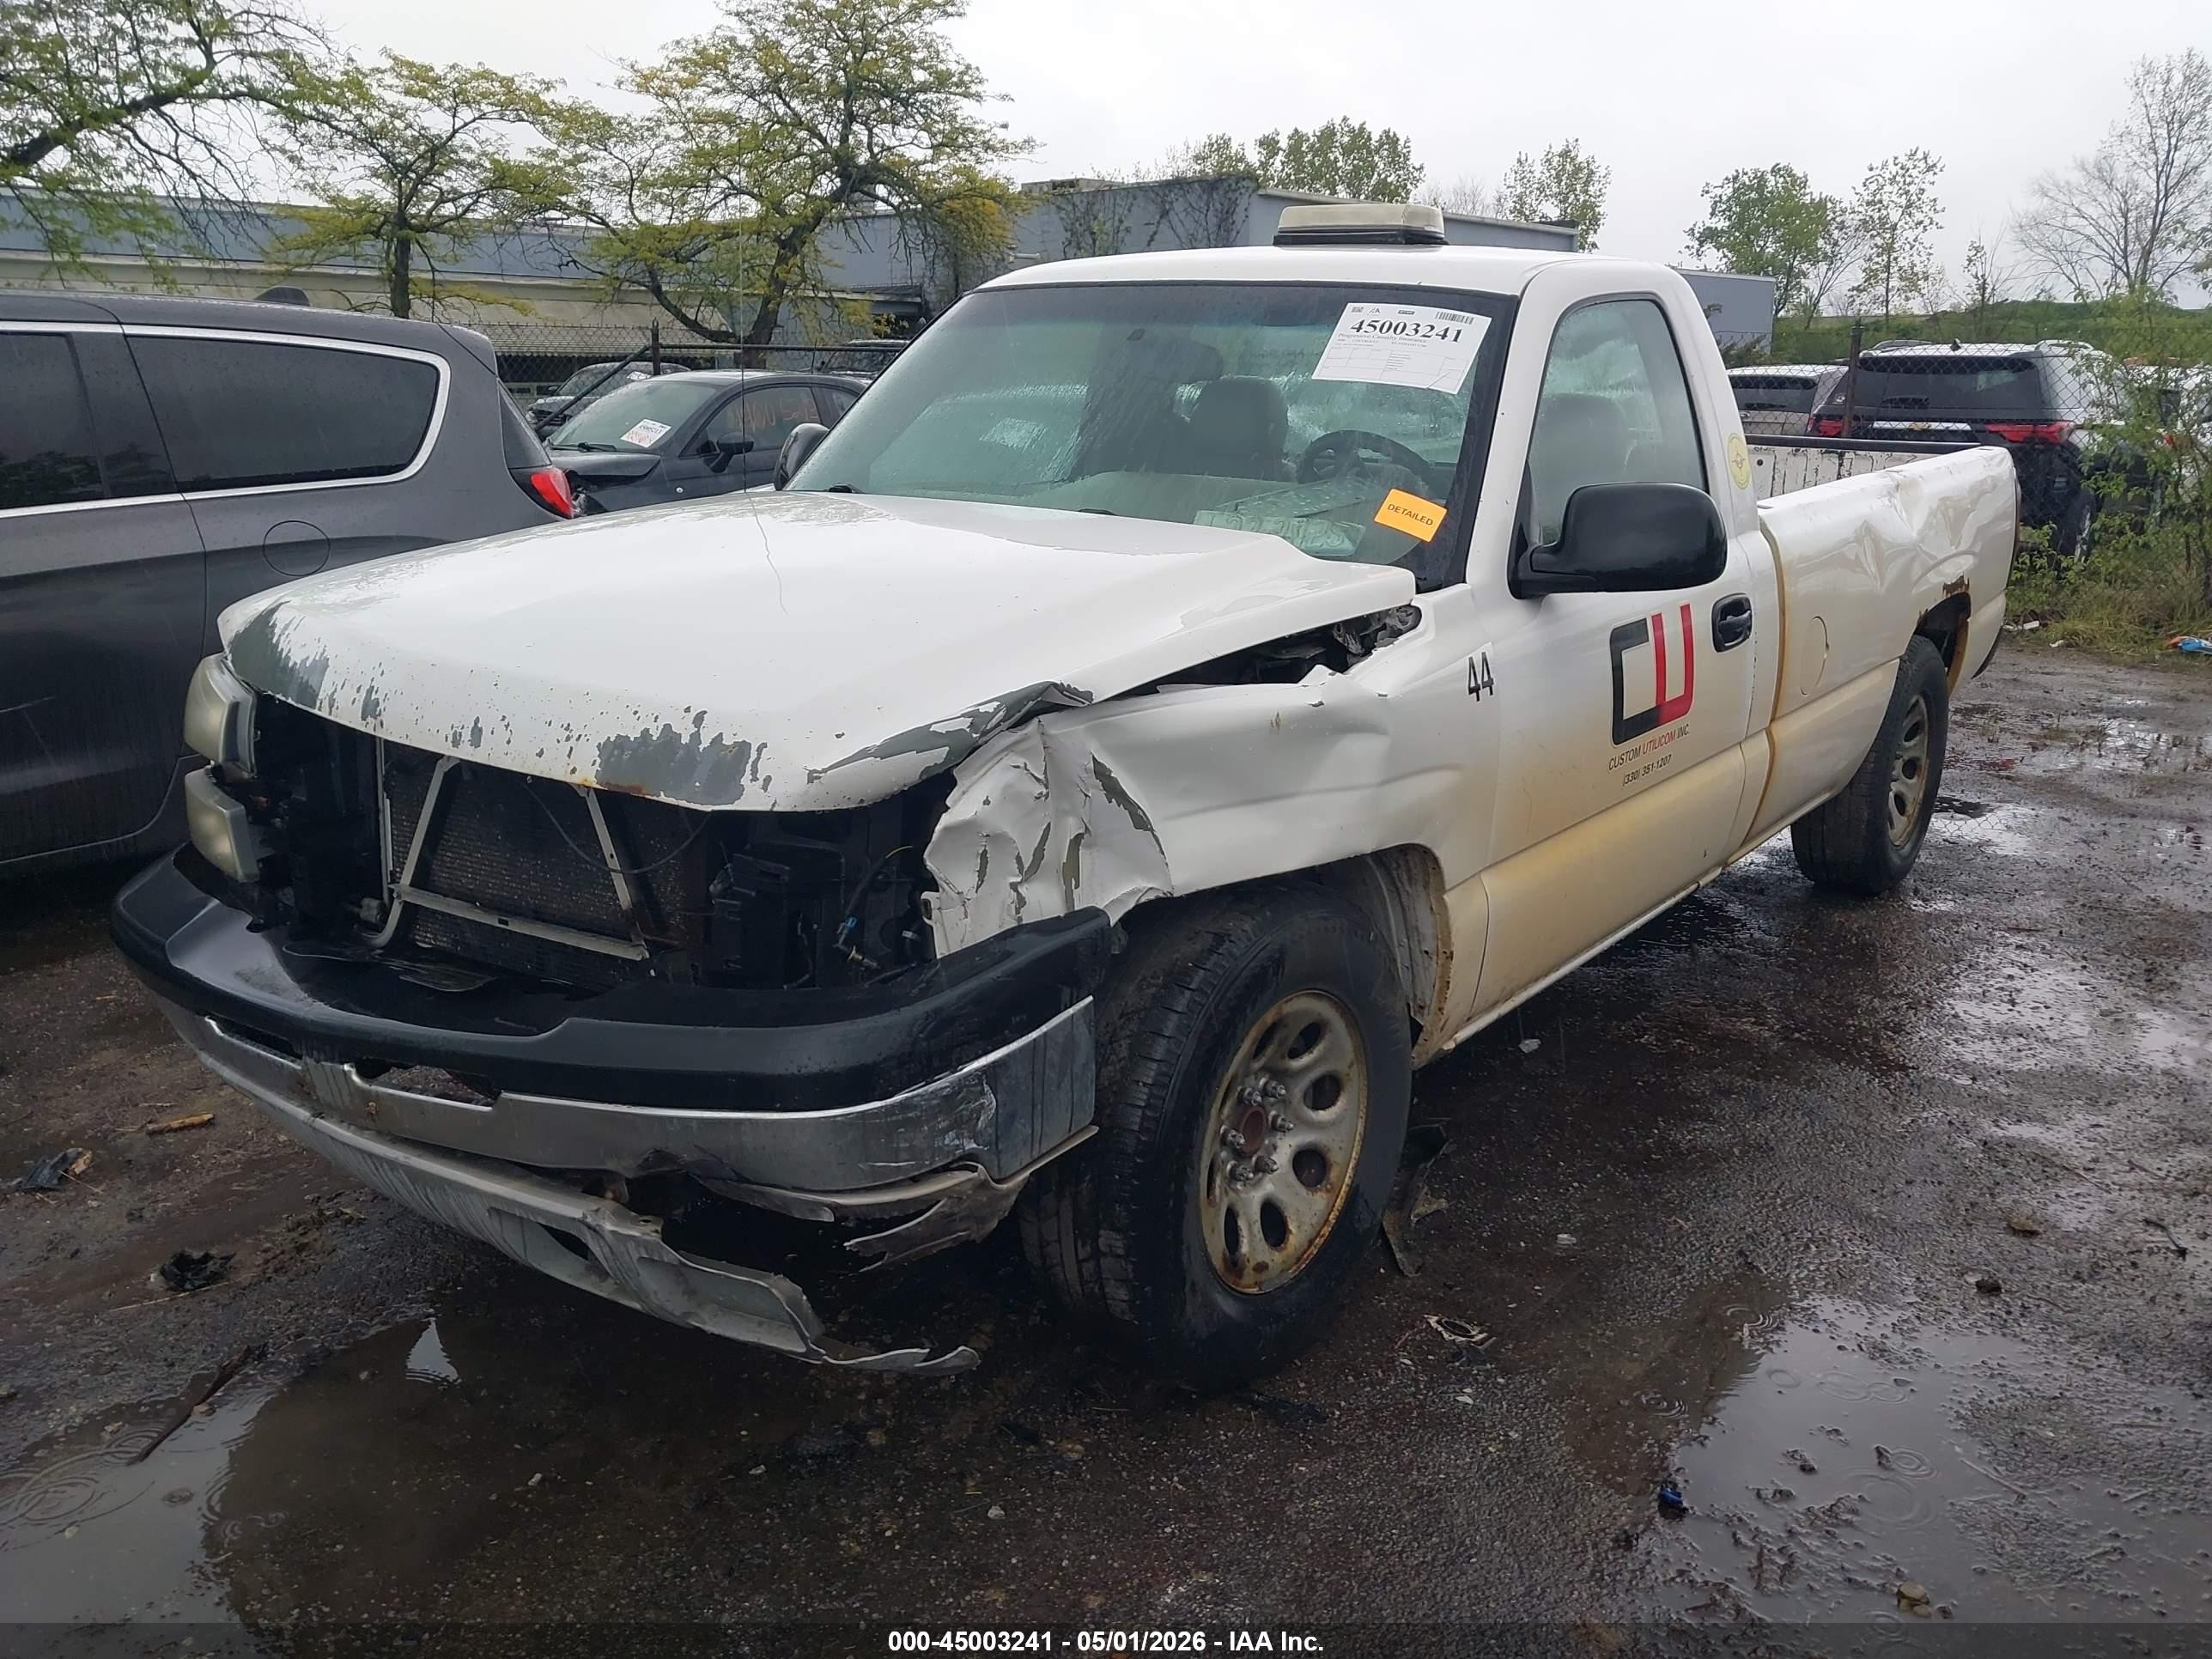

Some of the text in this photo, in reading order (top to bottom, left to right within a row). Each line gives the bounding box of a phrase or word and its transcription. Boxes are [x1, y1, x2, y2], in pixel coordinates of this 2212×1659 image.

[1351, 319, 1463, 343] 45003241
[1387, 503, 1434, 526] DETAILED
[1468, 651, 1494, 702] 44
[1608, 745, 1641, 771] CUSTOM
[1642, 729, 1676, 755] UTILICOM
[1623, 754, 1672, 787] (330) 351-1207
